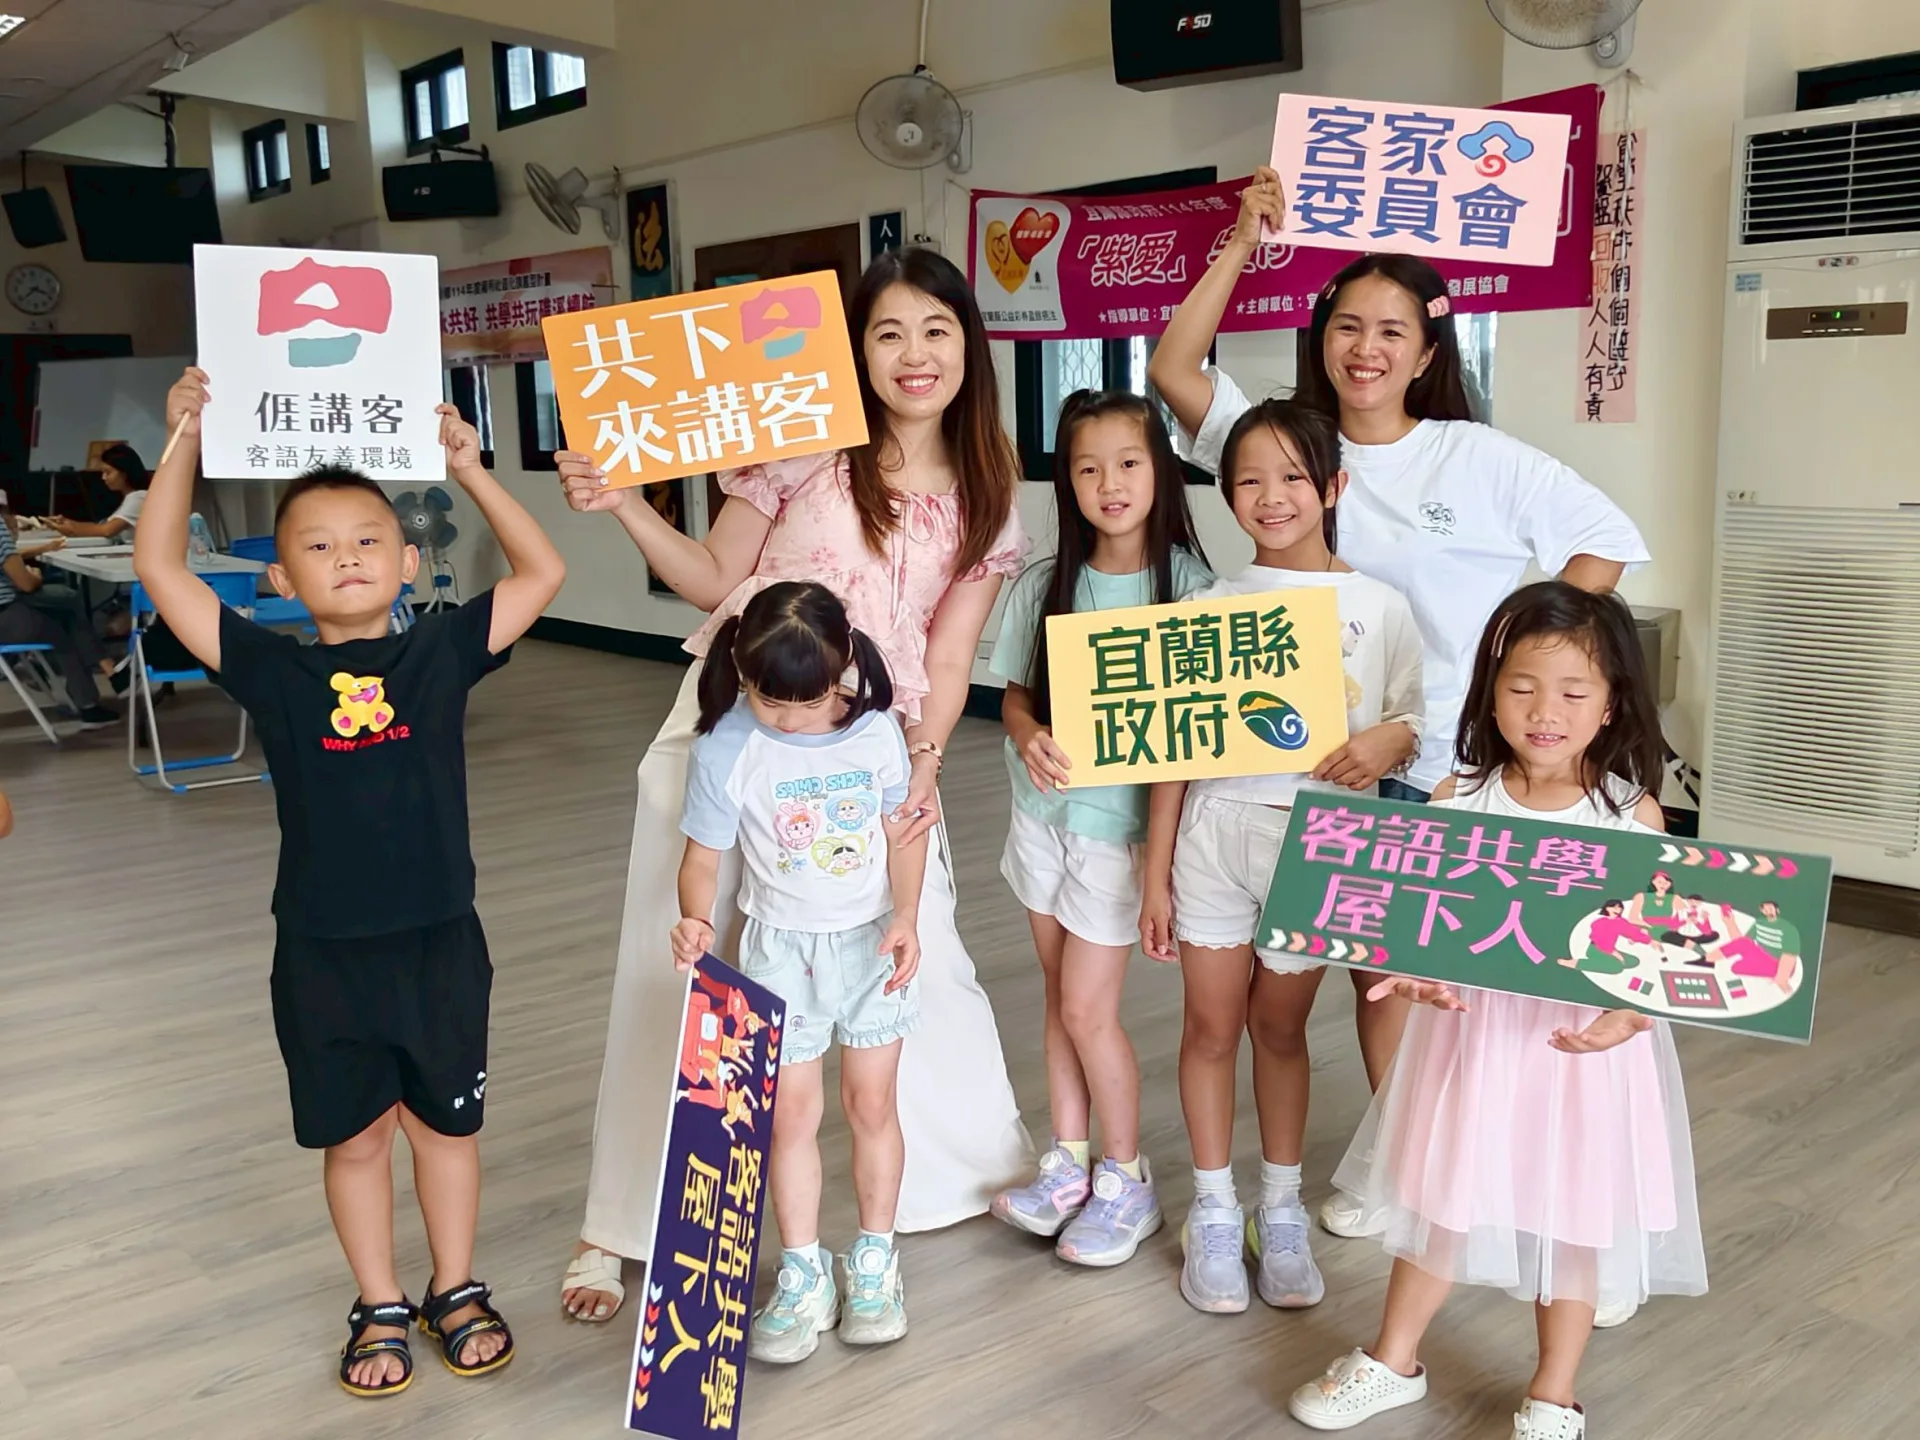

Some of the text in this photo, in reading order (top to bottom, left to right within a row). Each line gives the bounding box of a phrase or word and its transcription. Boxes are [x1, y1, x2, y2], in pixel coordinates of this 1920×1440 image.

[1304, 106, 1455, 176] 客家
[1292, 173, 1528, 249] 委員會
[572, 303, 731, 399] 共下
[246, 443, 413, 470] 客語友善環境
[587, 371, 834, 474] 來講客
[1088, 605, 1300, 695] 宜蘭縣
[322, 737, 357, 751] WHY
[1091, 691, 1229, 767] 政府
[1300, 806, 1608, 896] 客語共學
[1313, 873, 1546, 965] 屋下人
[659, 1152, 722, 1373] 屋下人
[700, 1142, 762, 1430] 客語共學
